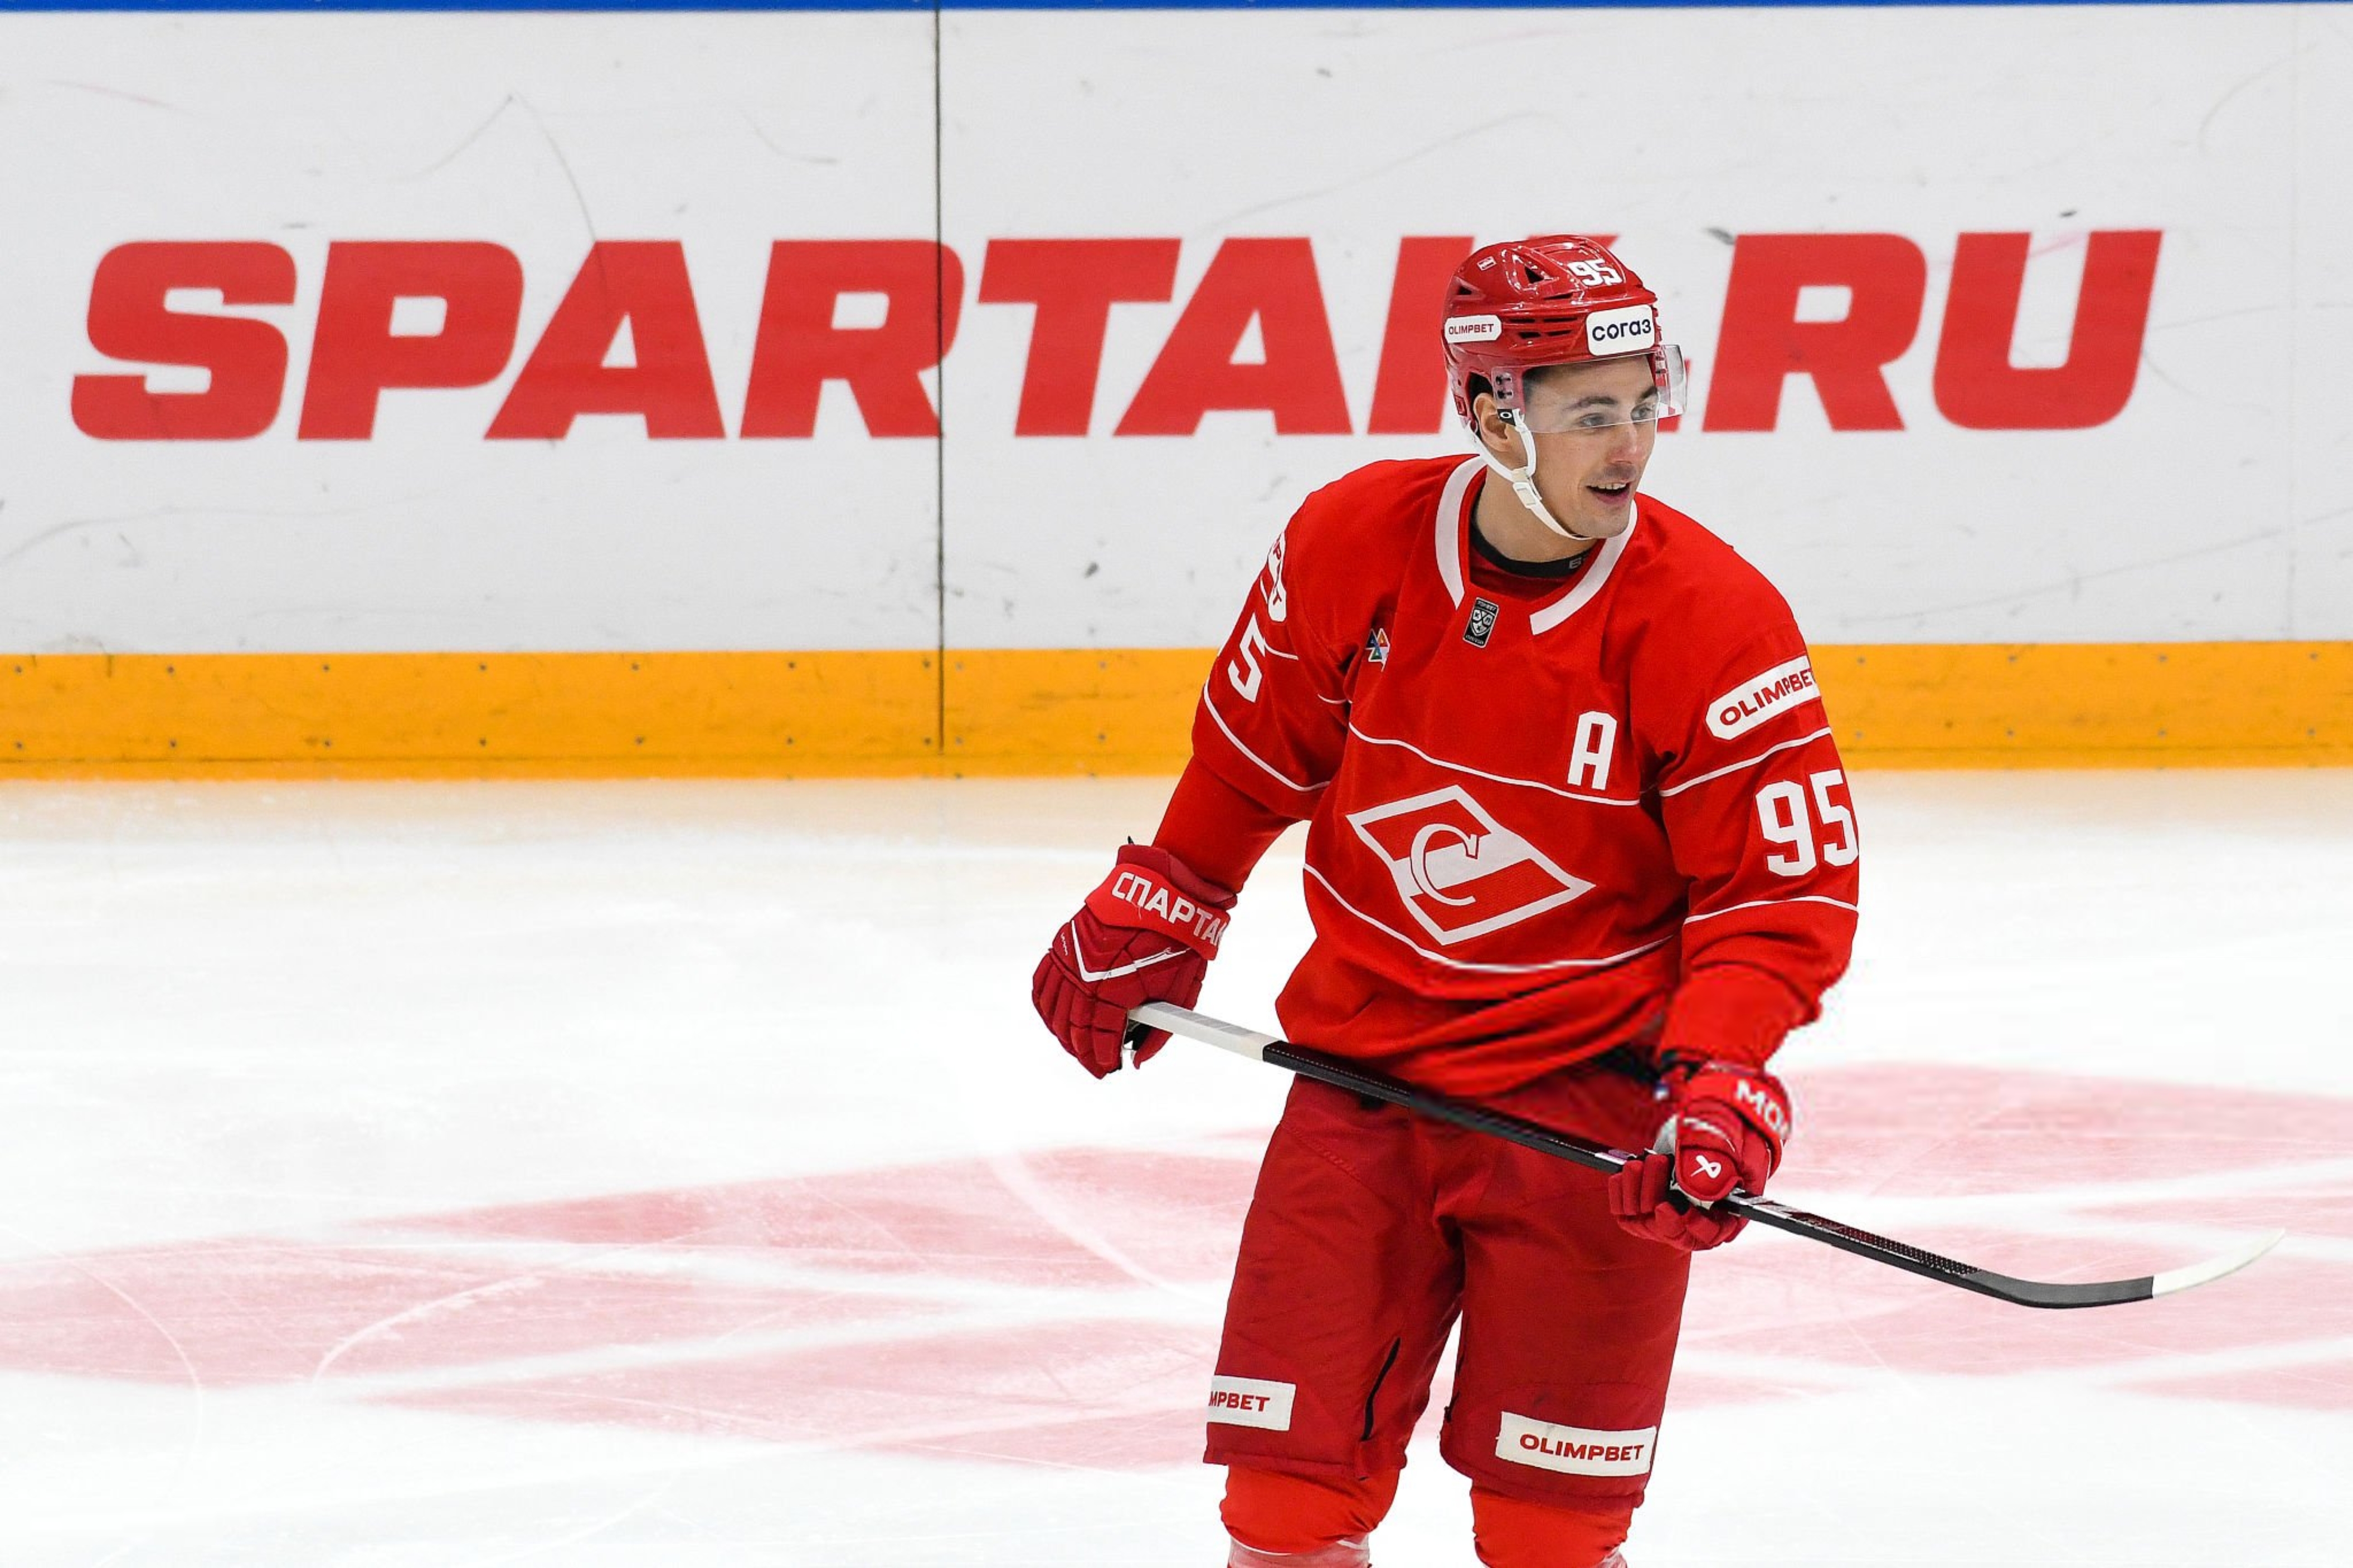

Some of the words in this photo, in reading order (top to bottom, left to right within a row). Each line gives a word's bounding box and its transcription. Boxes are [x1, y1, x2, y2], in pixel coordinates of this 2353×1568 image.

[1568, 258, 1622, 286] 95
[1448, 323, 1494, 335] OLIMPBET
[1592, 319, 1652, 342] согаз
[1567, 710, 1617, 791] A
[1755, 768, 1859, 876] 95
[1520, 1434, 1644, 1461] OLIMPBET
